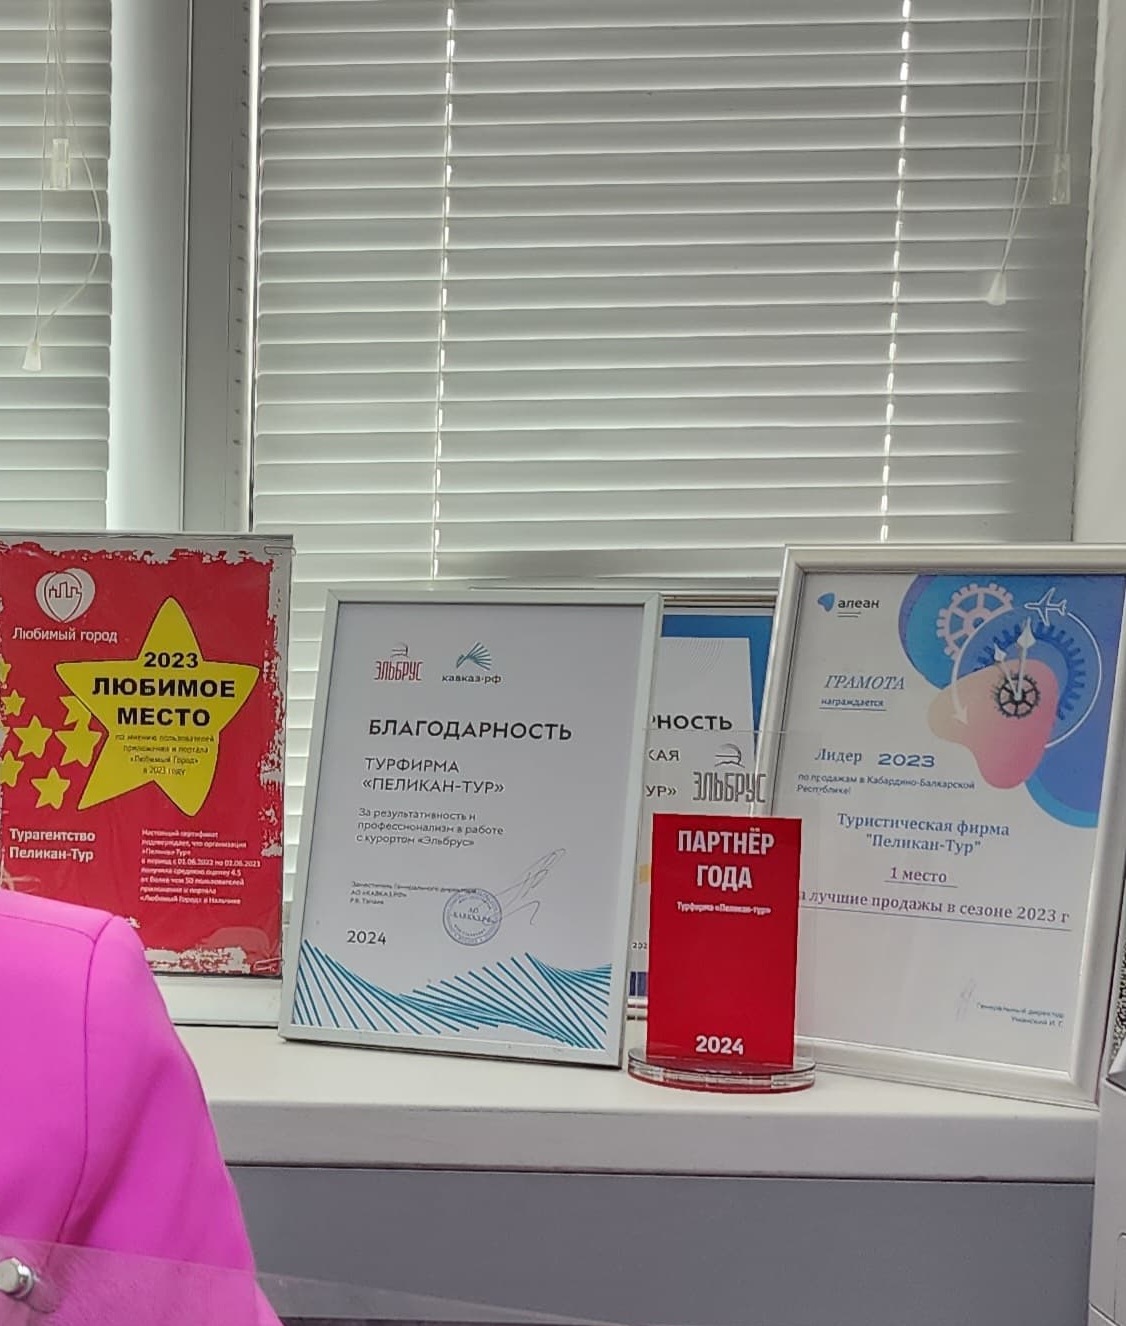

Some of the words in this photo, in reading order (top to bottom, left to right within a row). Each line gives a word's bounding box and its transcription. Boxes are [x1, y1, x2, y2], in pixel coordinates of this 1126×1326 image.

[838, 599, 880, 609] алеан
[12, 627, 76, 642] Любимый
[81, 630, 118, 643] город
[144, 652, 199, 668] 2023
[374, 661, 423, 681] ЭЛЬБРУС
[92, 677, 235, 698] ЛЮБИМОЕ
[824, 675, 905, 690] ГРАМОТА
[821, 698, 884, 708] награждается
[117, 707, 211, 727] МЕСТО
[369, 719, 572, 741] БЛАГОДАРНОСТЬ
[365, 757, 460, 773] ТУРФИРМА
[815, 749, 863, 765] Лидер
[878, 753, 935, 768] 2023
[362, 777, 505, 793] «ПЕЛИКАН-ТУР»
[692, 771, 766, 803] ЭЛЬБРУС
[358, 808, 371, 817] За
[374, 809, 467, 821] результативность
[357, 822, 454, 833] профессионализм
[465, 825, 504, 836] работе
[837, 813, 953, 833] Туристическая
[957, 820, 1010, 838] фирма
[9, 828, 96, 843] Турагентство
[677, 827, 775, 855] ПАРТНЁР
[866, 833, 981, 856] "Пеликан-Тур"
[9, 846, 94, 863] Пеликан-Тур
[697, 865, 753, 891] ГОДА
[890, 867, 898, 880] 1
[902, 870, 947, 883] место
[809, 890, 868, 906] лучшие
[947, 903, 955, 913] в
[959, 904, 1013, 919] сезоне
[1016, 906, 1057, 923] 2023
[346, 930, 387, 945] 2024
[695, 1035, 744, 1055] 2024
